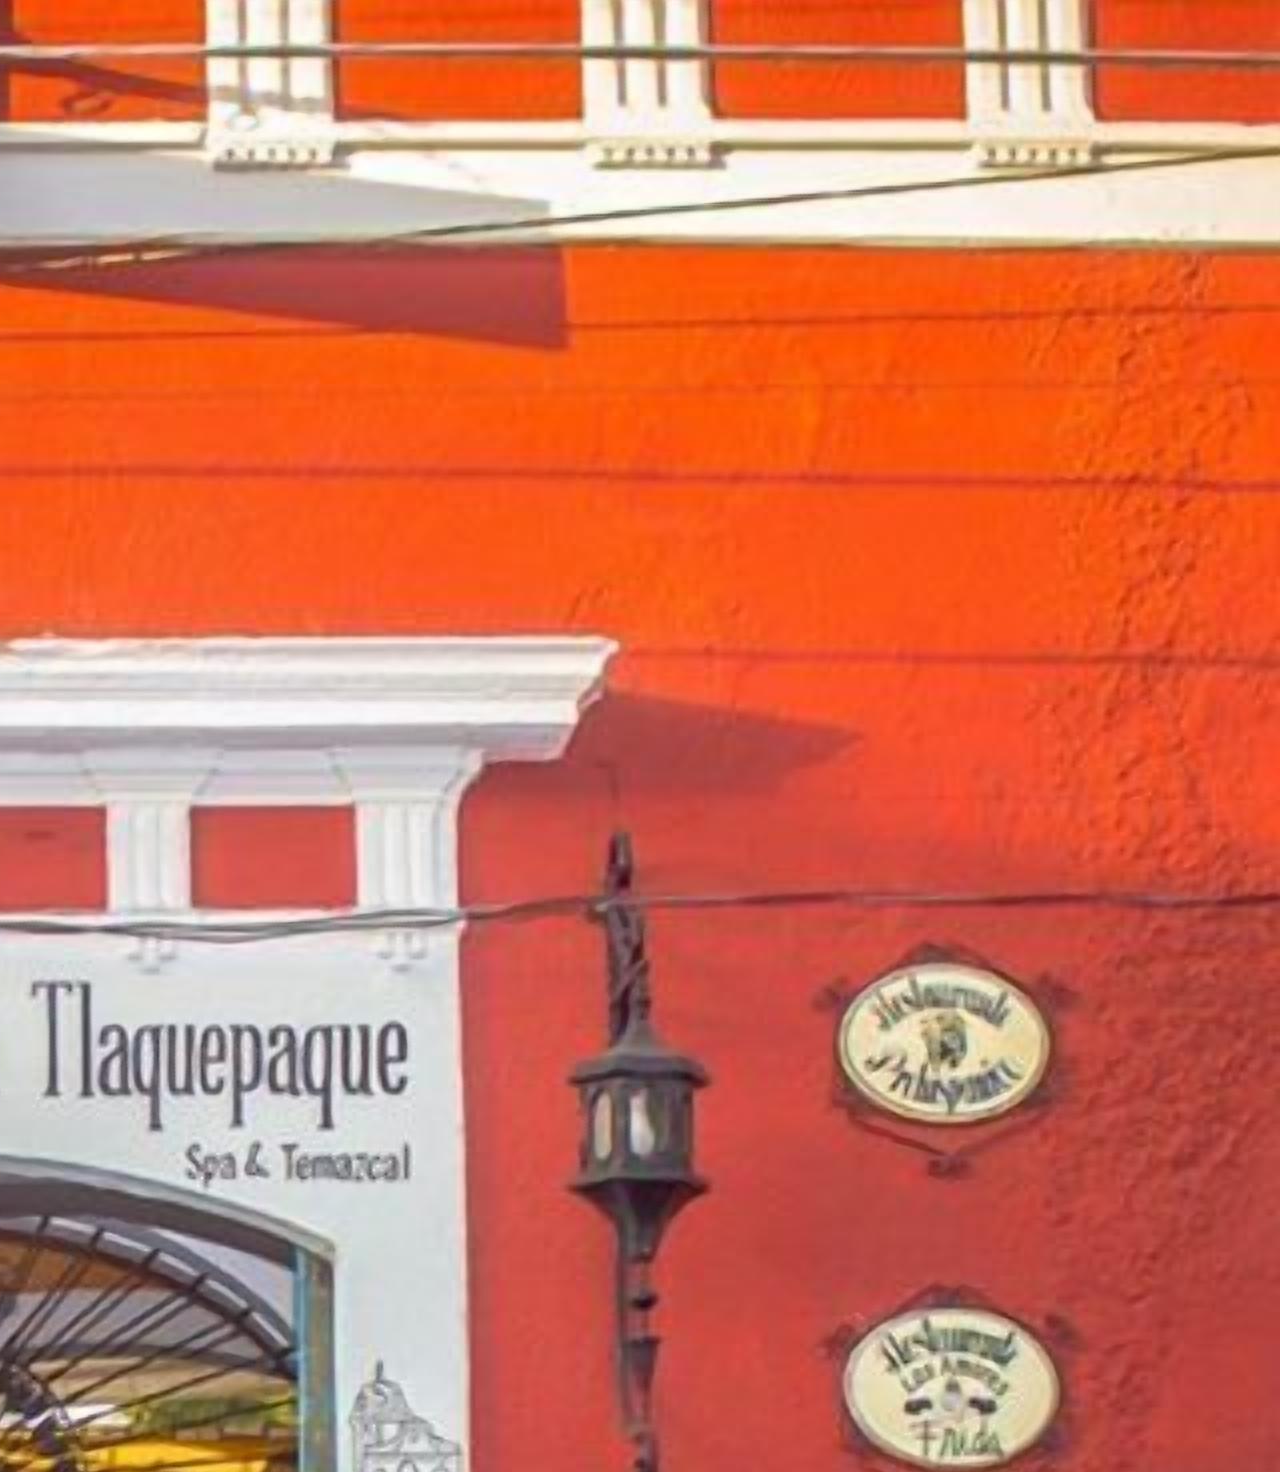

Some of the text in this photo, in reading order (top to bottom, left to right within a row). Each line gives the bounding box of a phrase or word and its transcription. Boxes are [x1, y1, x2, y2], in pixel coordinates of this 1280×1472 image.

[32, 980, 409, 1131] Tlaquepaque
[185, 1140, 411, 1188] Spa & Temazcal
